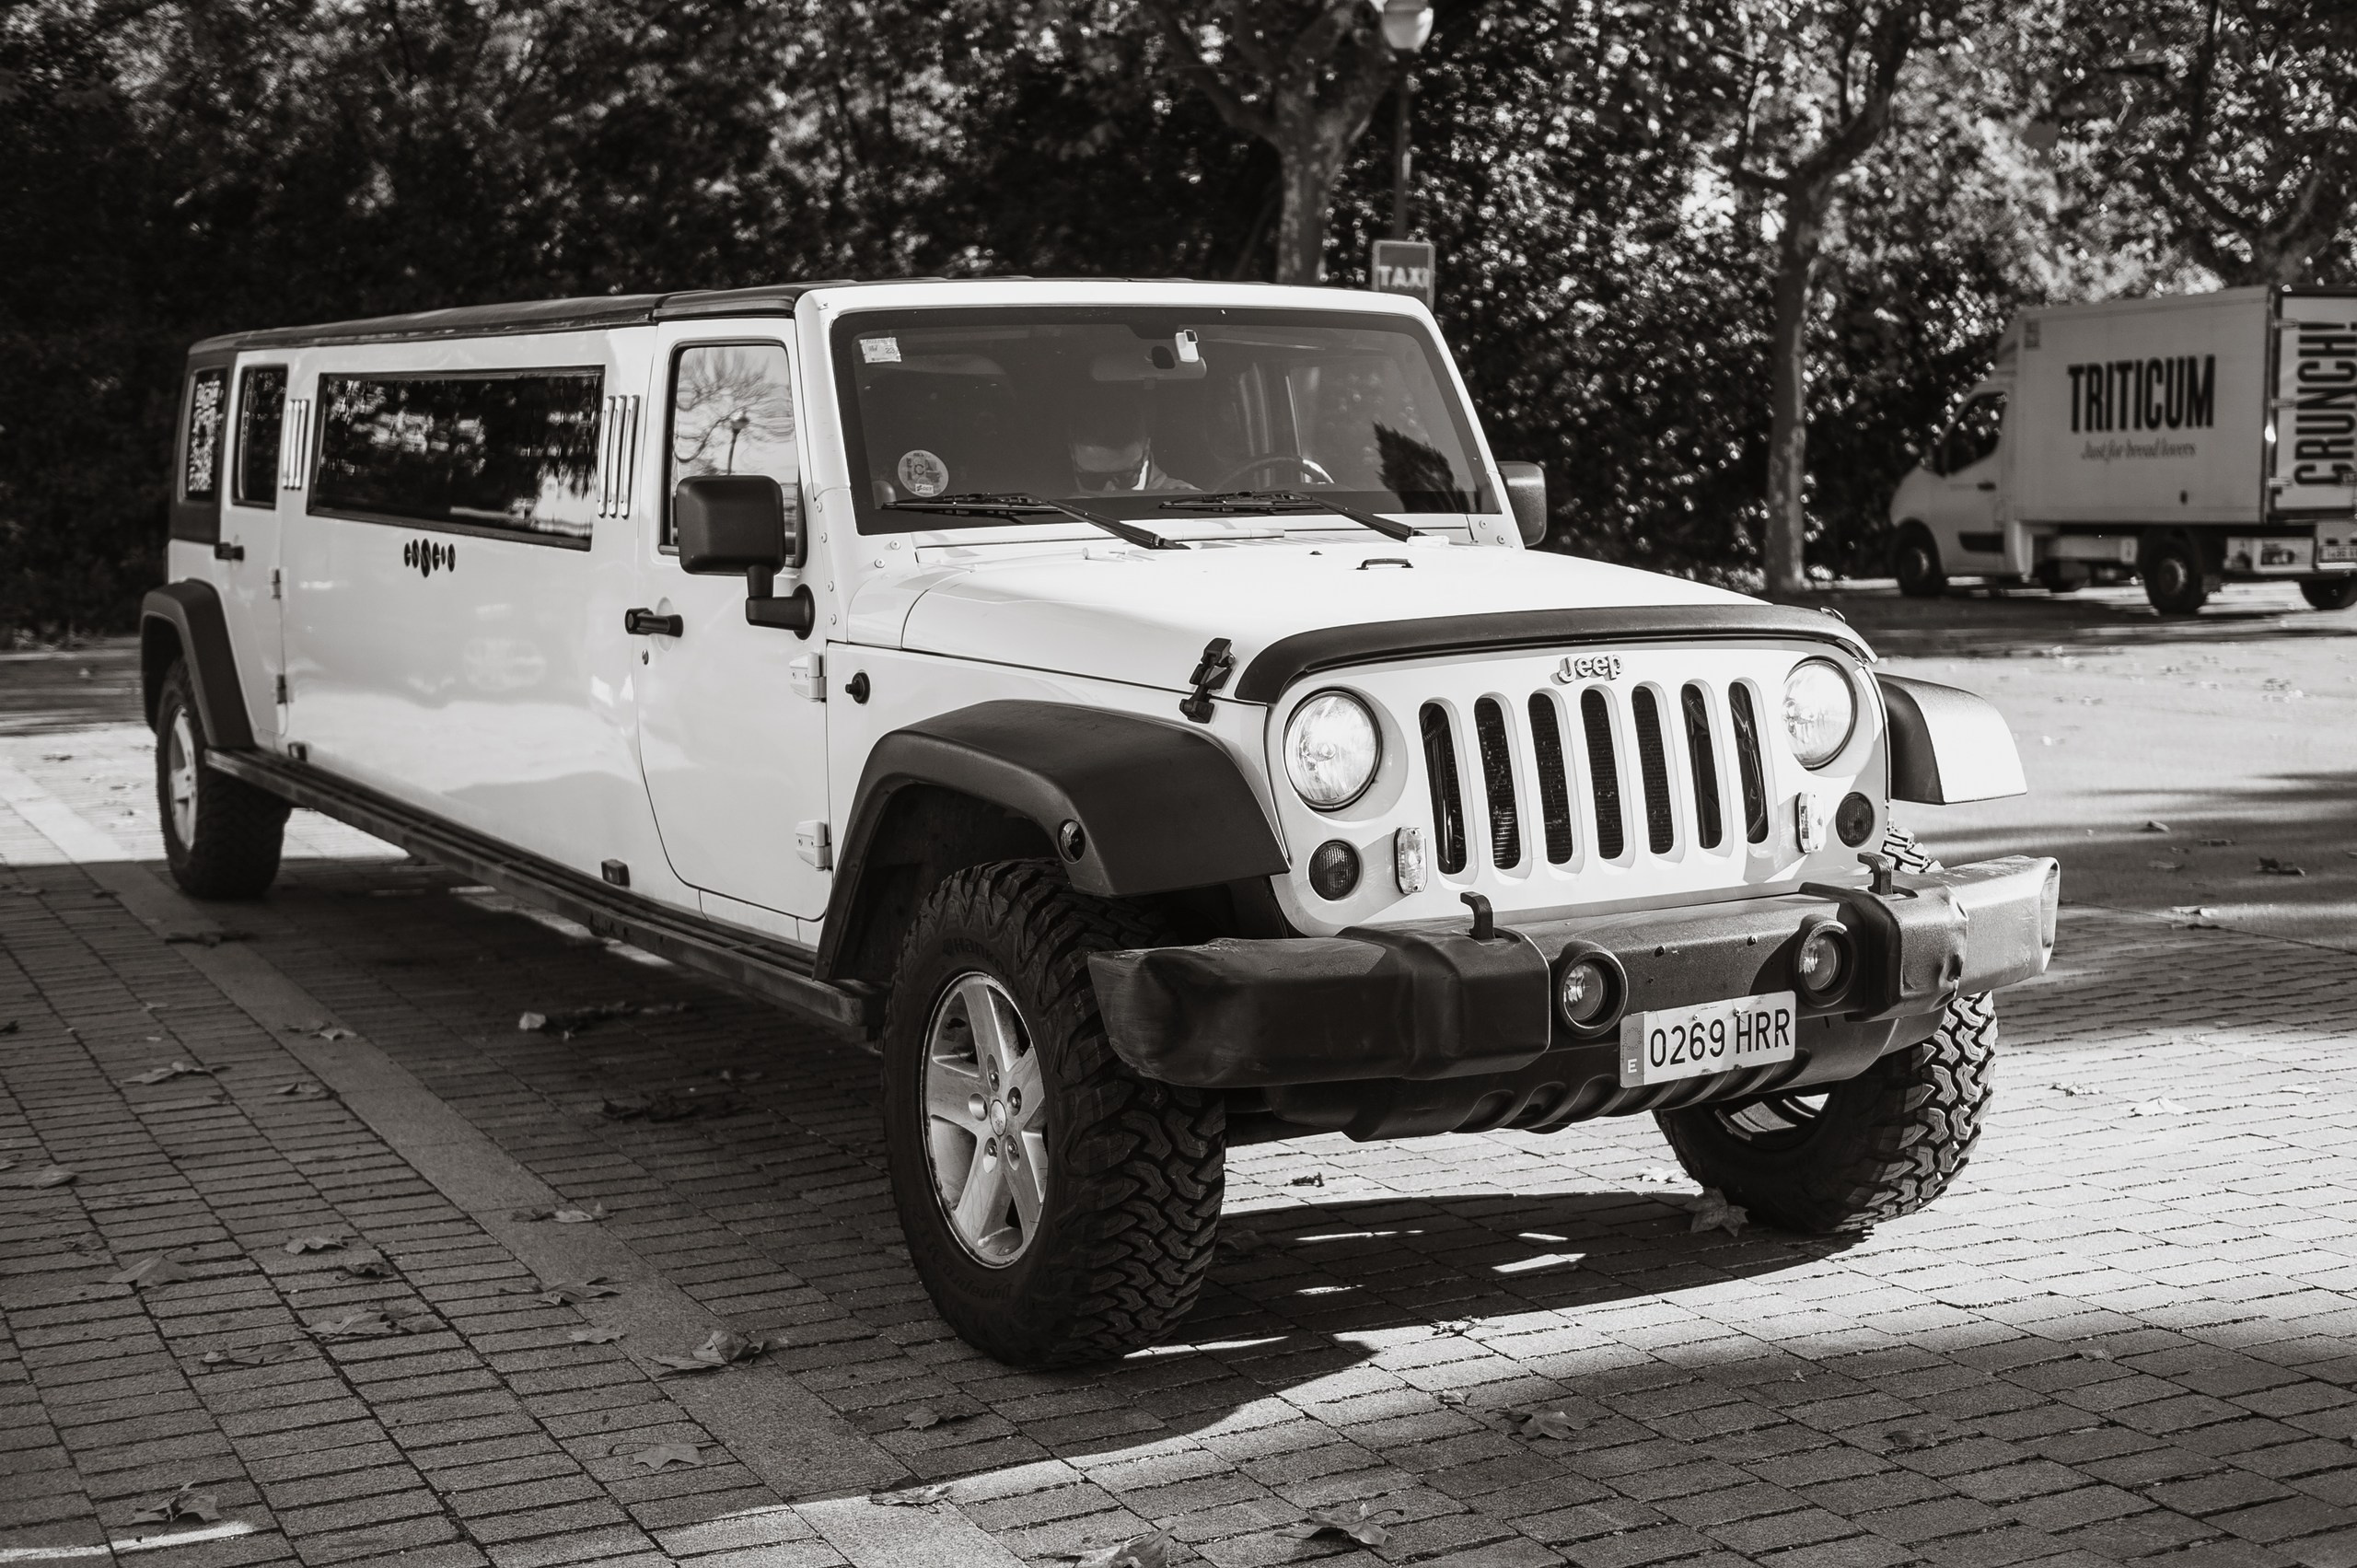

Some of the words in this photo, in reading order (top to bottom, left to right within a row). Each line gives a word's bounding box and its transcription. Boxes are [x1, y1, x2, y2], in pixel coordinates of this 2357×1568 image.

[1376, 265, 1429, 288] TAXI
[2068, 354, 2216, 434] TRITICUM
[2293, 322, 2357, 486] CRUNCH!
[1554, 655, 1622, 683] Jeep
[1650, 1019, 1725, 1067] 0269
[1736, 1008, 1790, 1053] HRR
[1627, 1058, 1638, 1074] E
